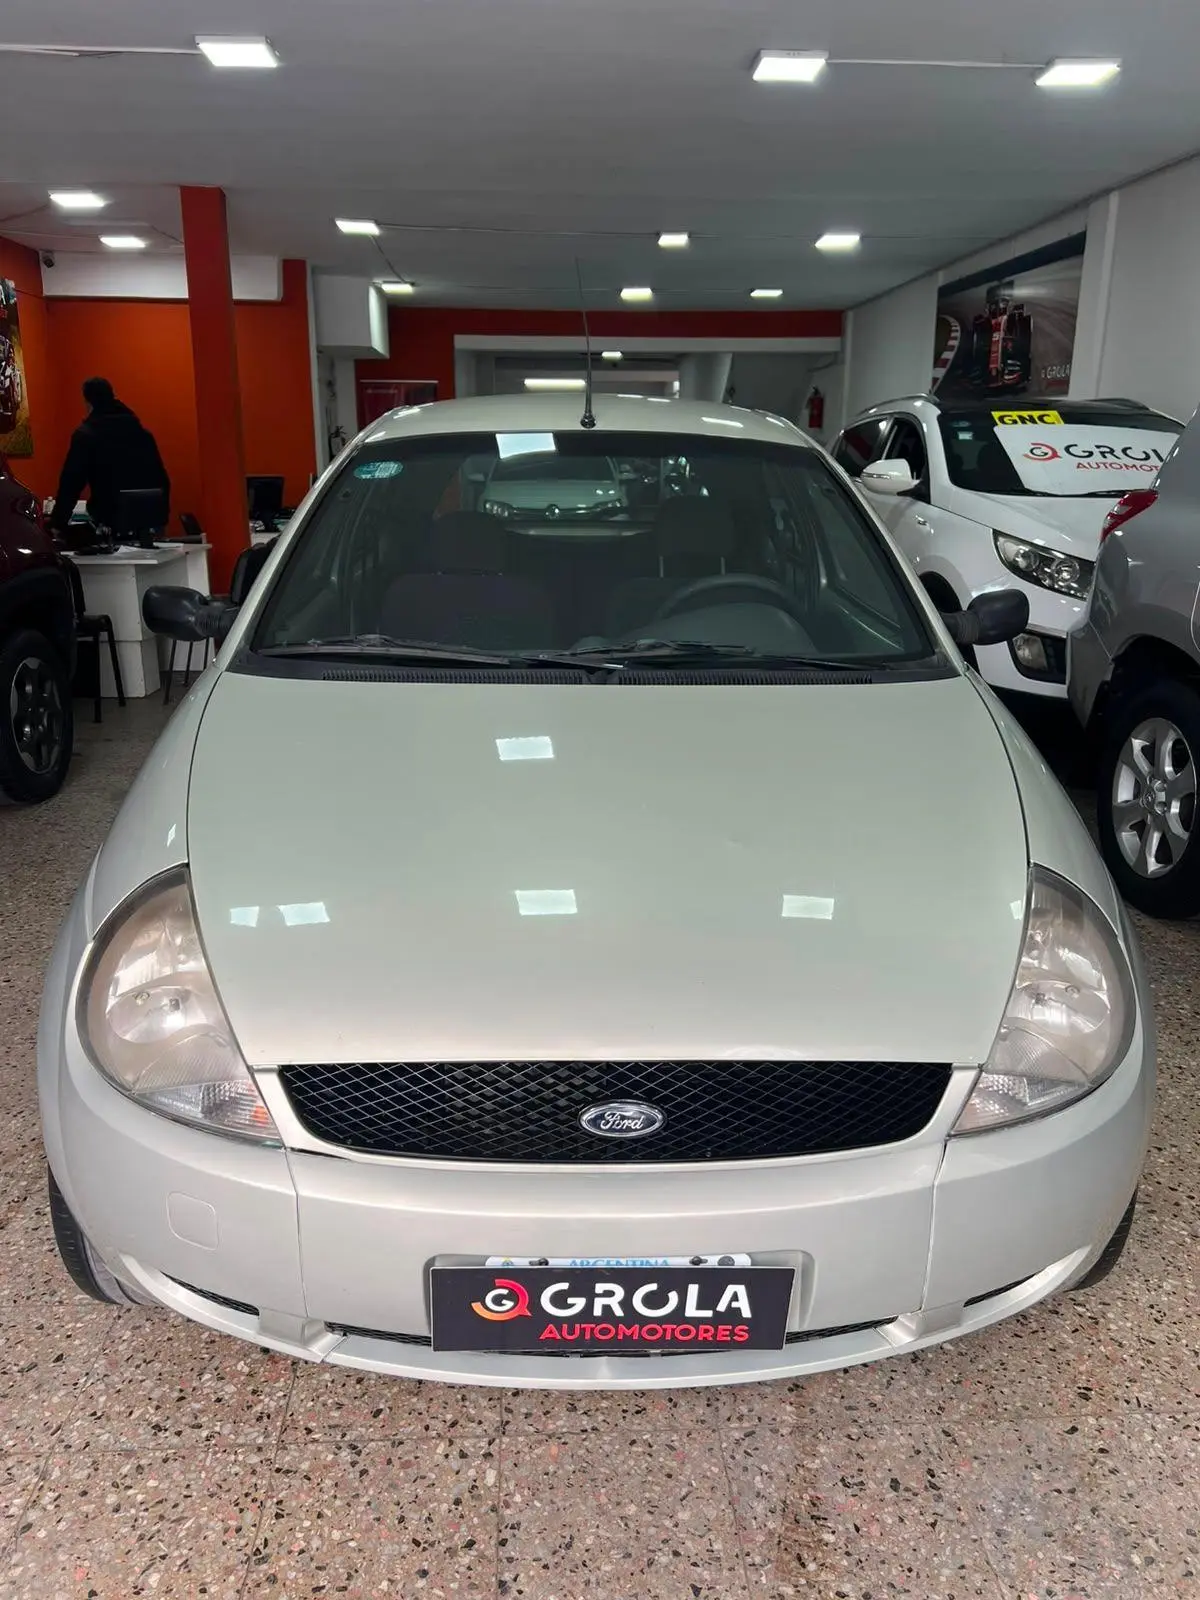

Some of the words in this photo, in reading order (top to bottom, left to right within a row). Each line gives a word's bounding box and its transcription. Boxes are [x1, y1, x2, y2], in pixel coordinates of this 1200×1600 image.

[998, 413, 1056, 425] GNC
[600, 1111, 646, 1130] Ford
[539, 1281, 752, 1319] GROLA
[538, 1322, 750, 1343] AUTOMOTORES
